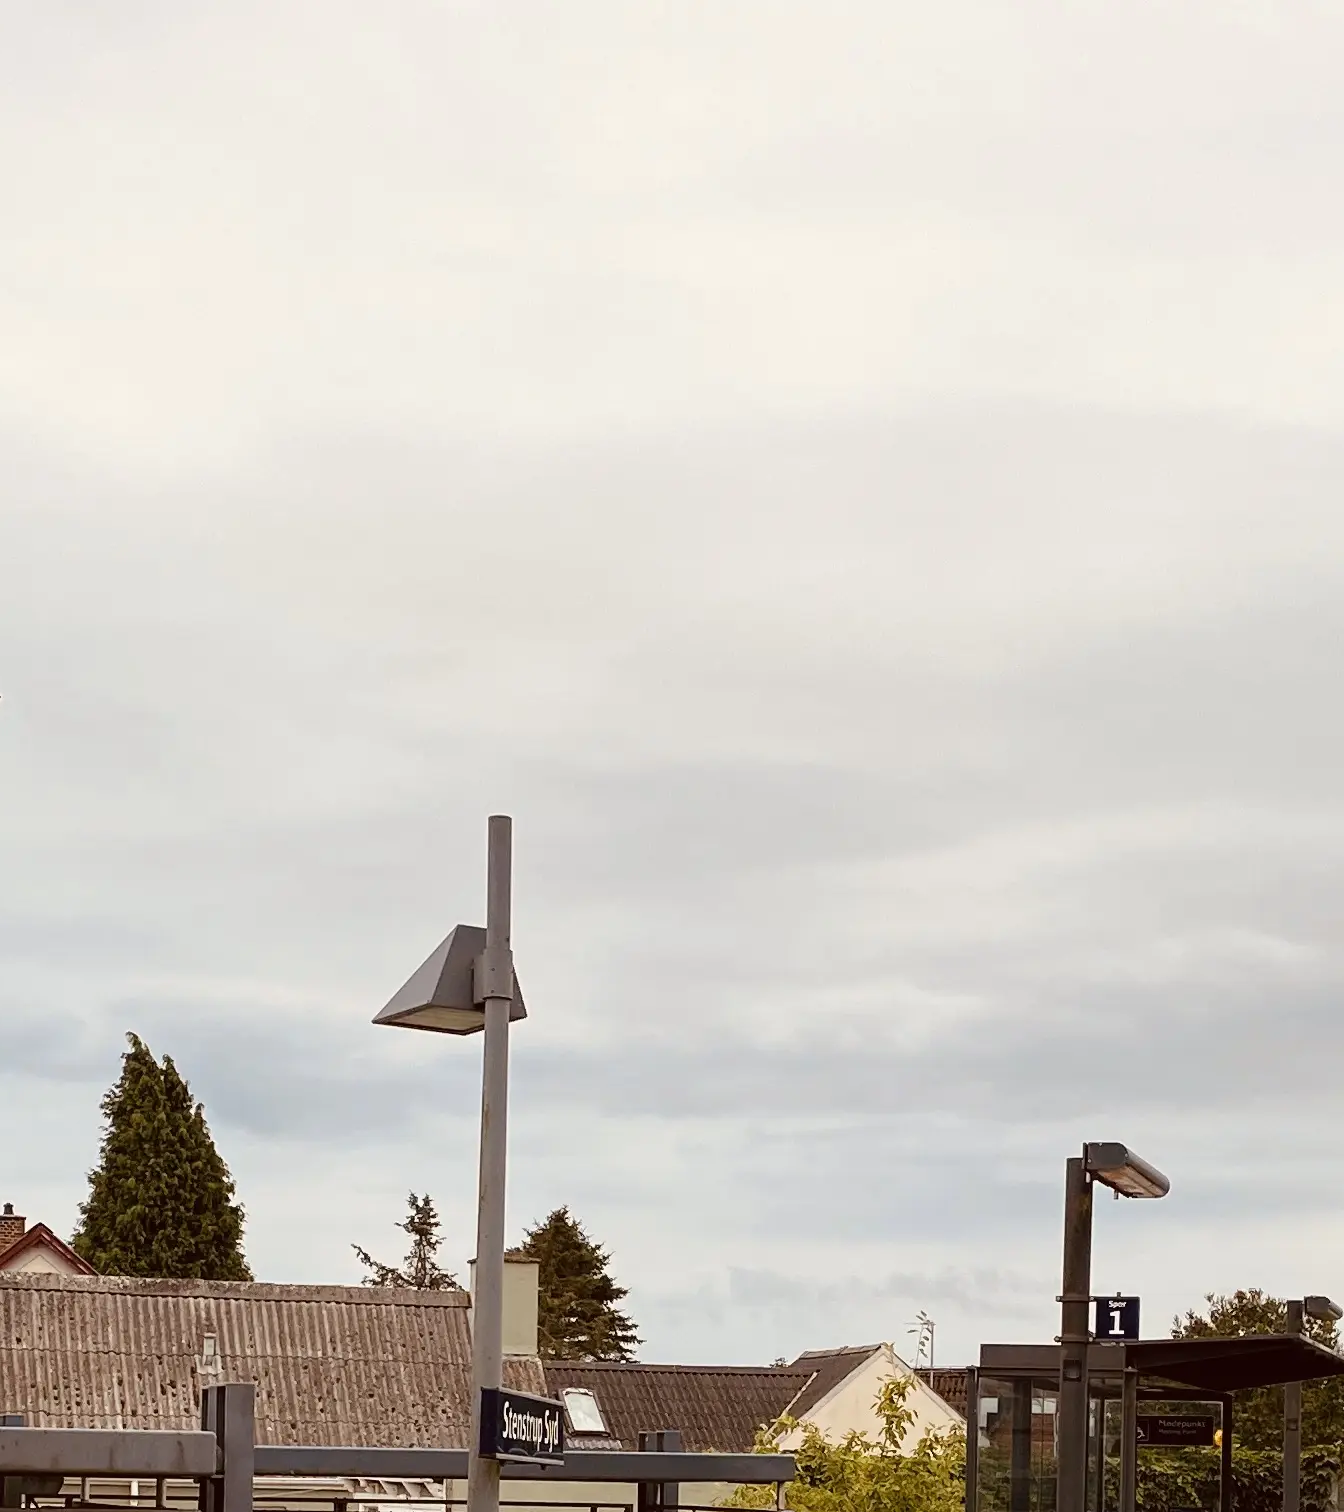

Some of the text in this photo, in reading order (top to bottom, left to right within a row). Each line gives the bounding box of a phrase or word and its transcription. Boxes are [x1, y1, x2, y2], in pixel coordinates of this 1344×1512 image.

[1108, 1310, 1125, 1335] 1
[502, 1400, 559, 1453] Stenstrup Syd
